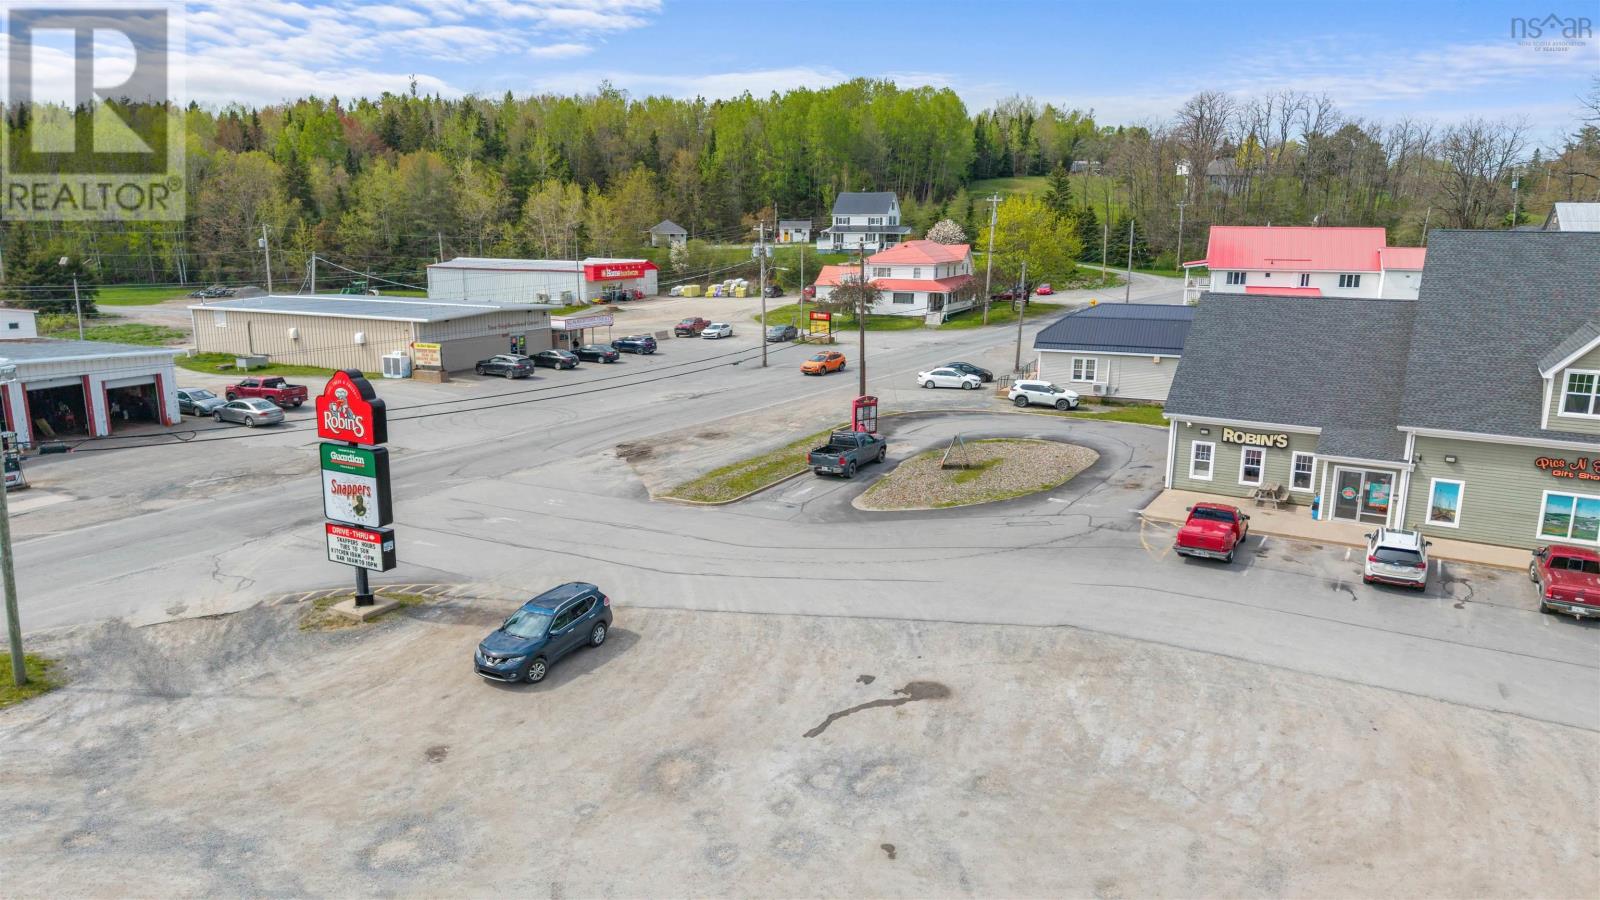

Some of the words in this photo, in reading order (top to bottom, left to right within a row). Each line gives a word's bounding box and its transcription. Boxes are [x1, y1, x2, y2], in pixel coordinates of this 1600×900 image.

[1222, 427, 1288, 448] ROBIN'S
[330, 451, 365, 464] Guardian
[1535, 457, 1565, 469] Pics
[1569, 458, 1588, 470] N
[1552, 470, 1574, 478] Gift
[330, 479, 372, 500] Snappers
[331, 526, 369, 540] DRIVE-THRU
